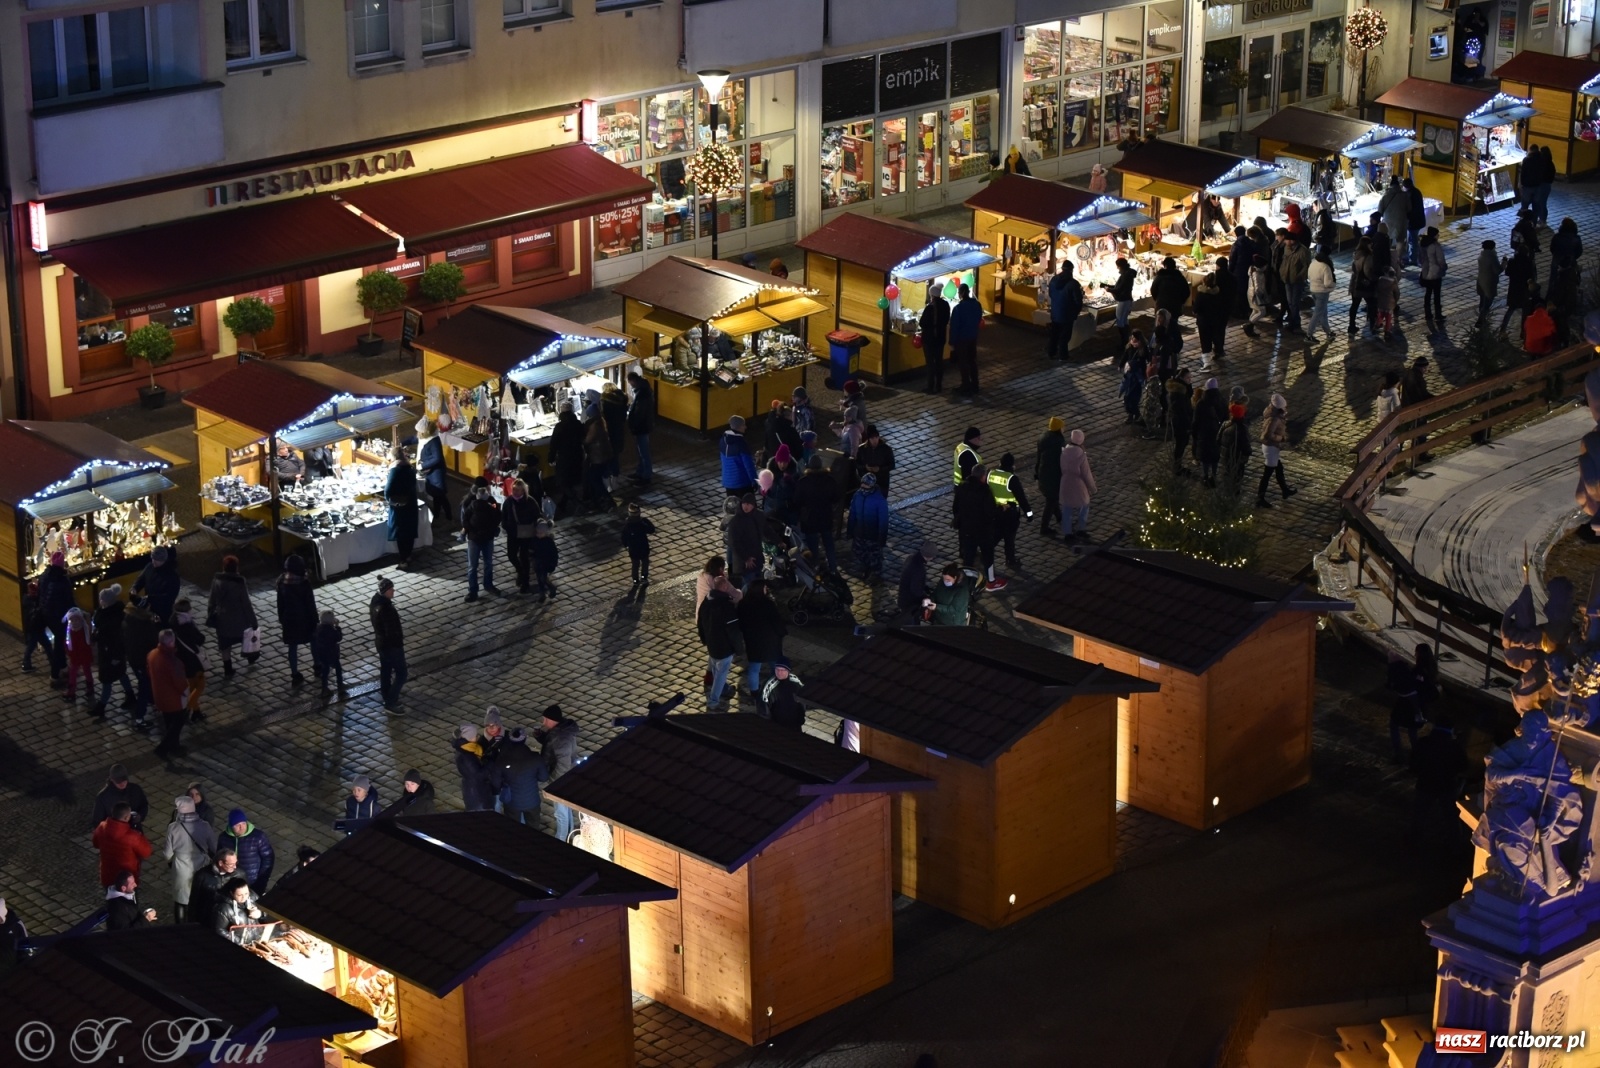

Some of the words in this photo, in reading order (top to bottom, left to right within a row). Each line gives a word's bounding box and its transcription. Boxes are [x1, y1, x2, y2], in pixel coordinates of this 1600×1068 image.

[1149, 23, 1182, 37] empik.com
[886, 58, 940, 89] empik
[596, 129, 640, 142] empik.com
[237, 149, 416, 202] RESTAURACJA
[518, 235, 533, 243] SMAKI
[534, 232, 551, 240] ŚWIATA
[402, 261, 421, 270] ŚWIATA
